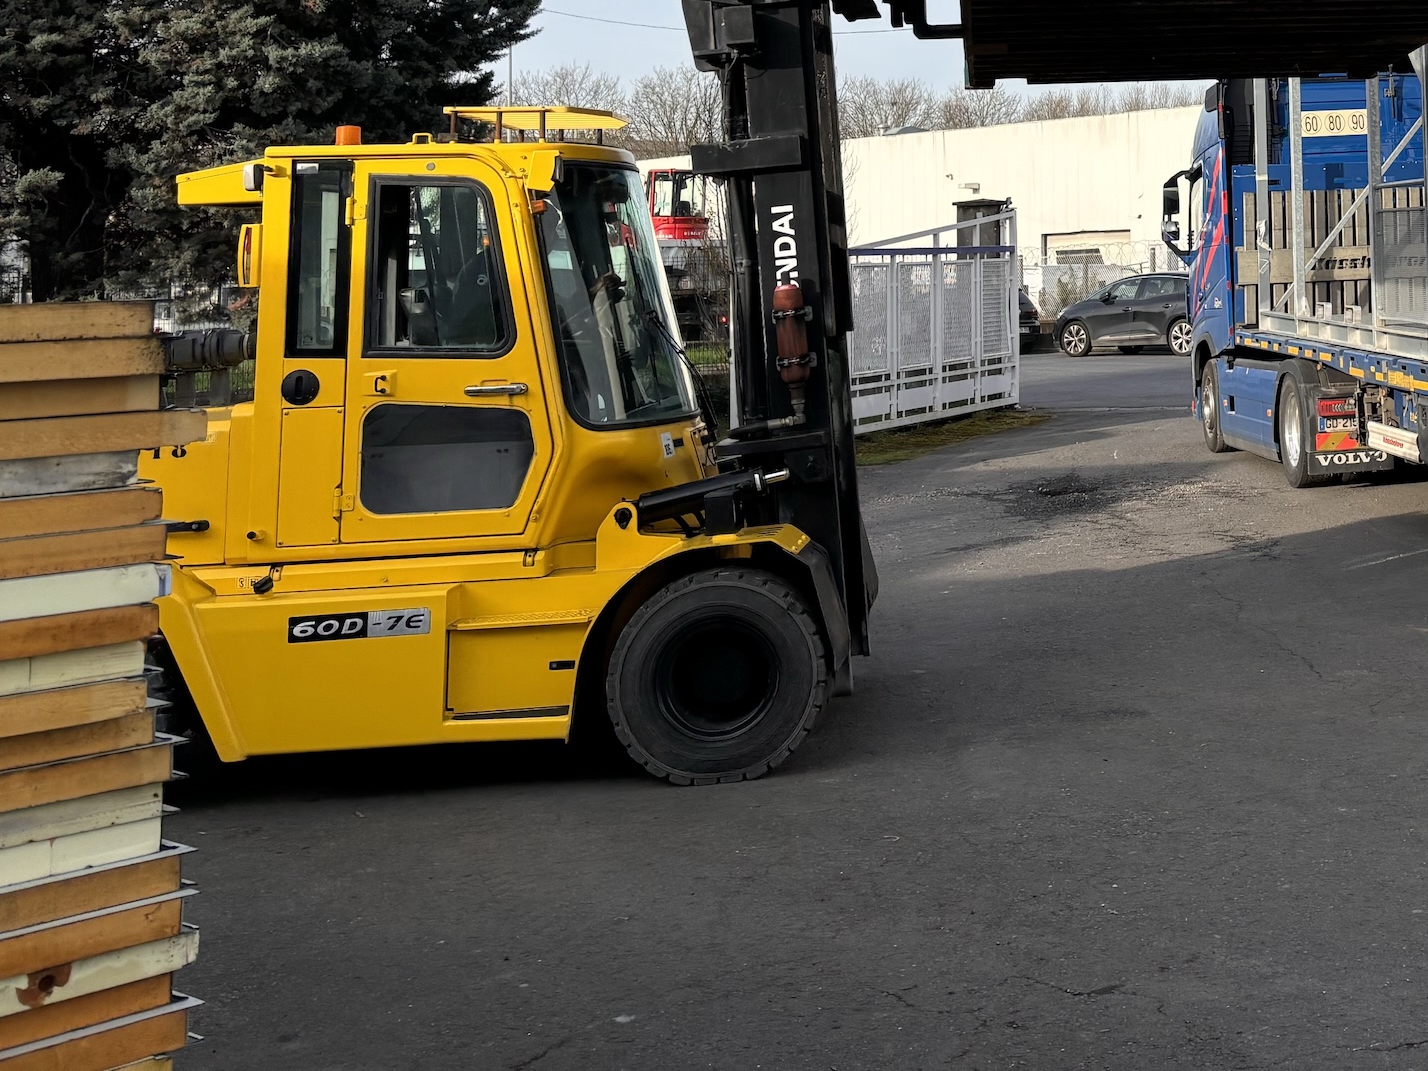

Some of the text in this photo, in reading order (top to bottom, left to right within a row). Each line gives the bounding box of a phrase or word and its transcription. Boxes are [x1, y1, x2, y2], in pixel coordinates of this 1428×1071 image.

[1305, 115, 1318, 132] 60
[1328, 115, 1341, 131] 80
[1351, 114, 1365, 130] 90
[1315, 450, 1388, 467] VOLVO
